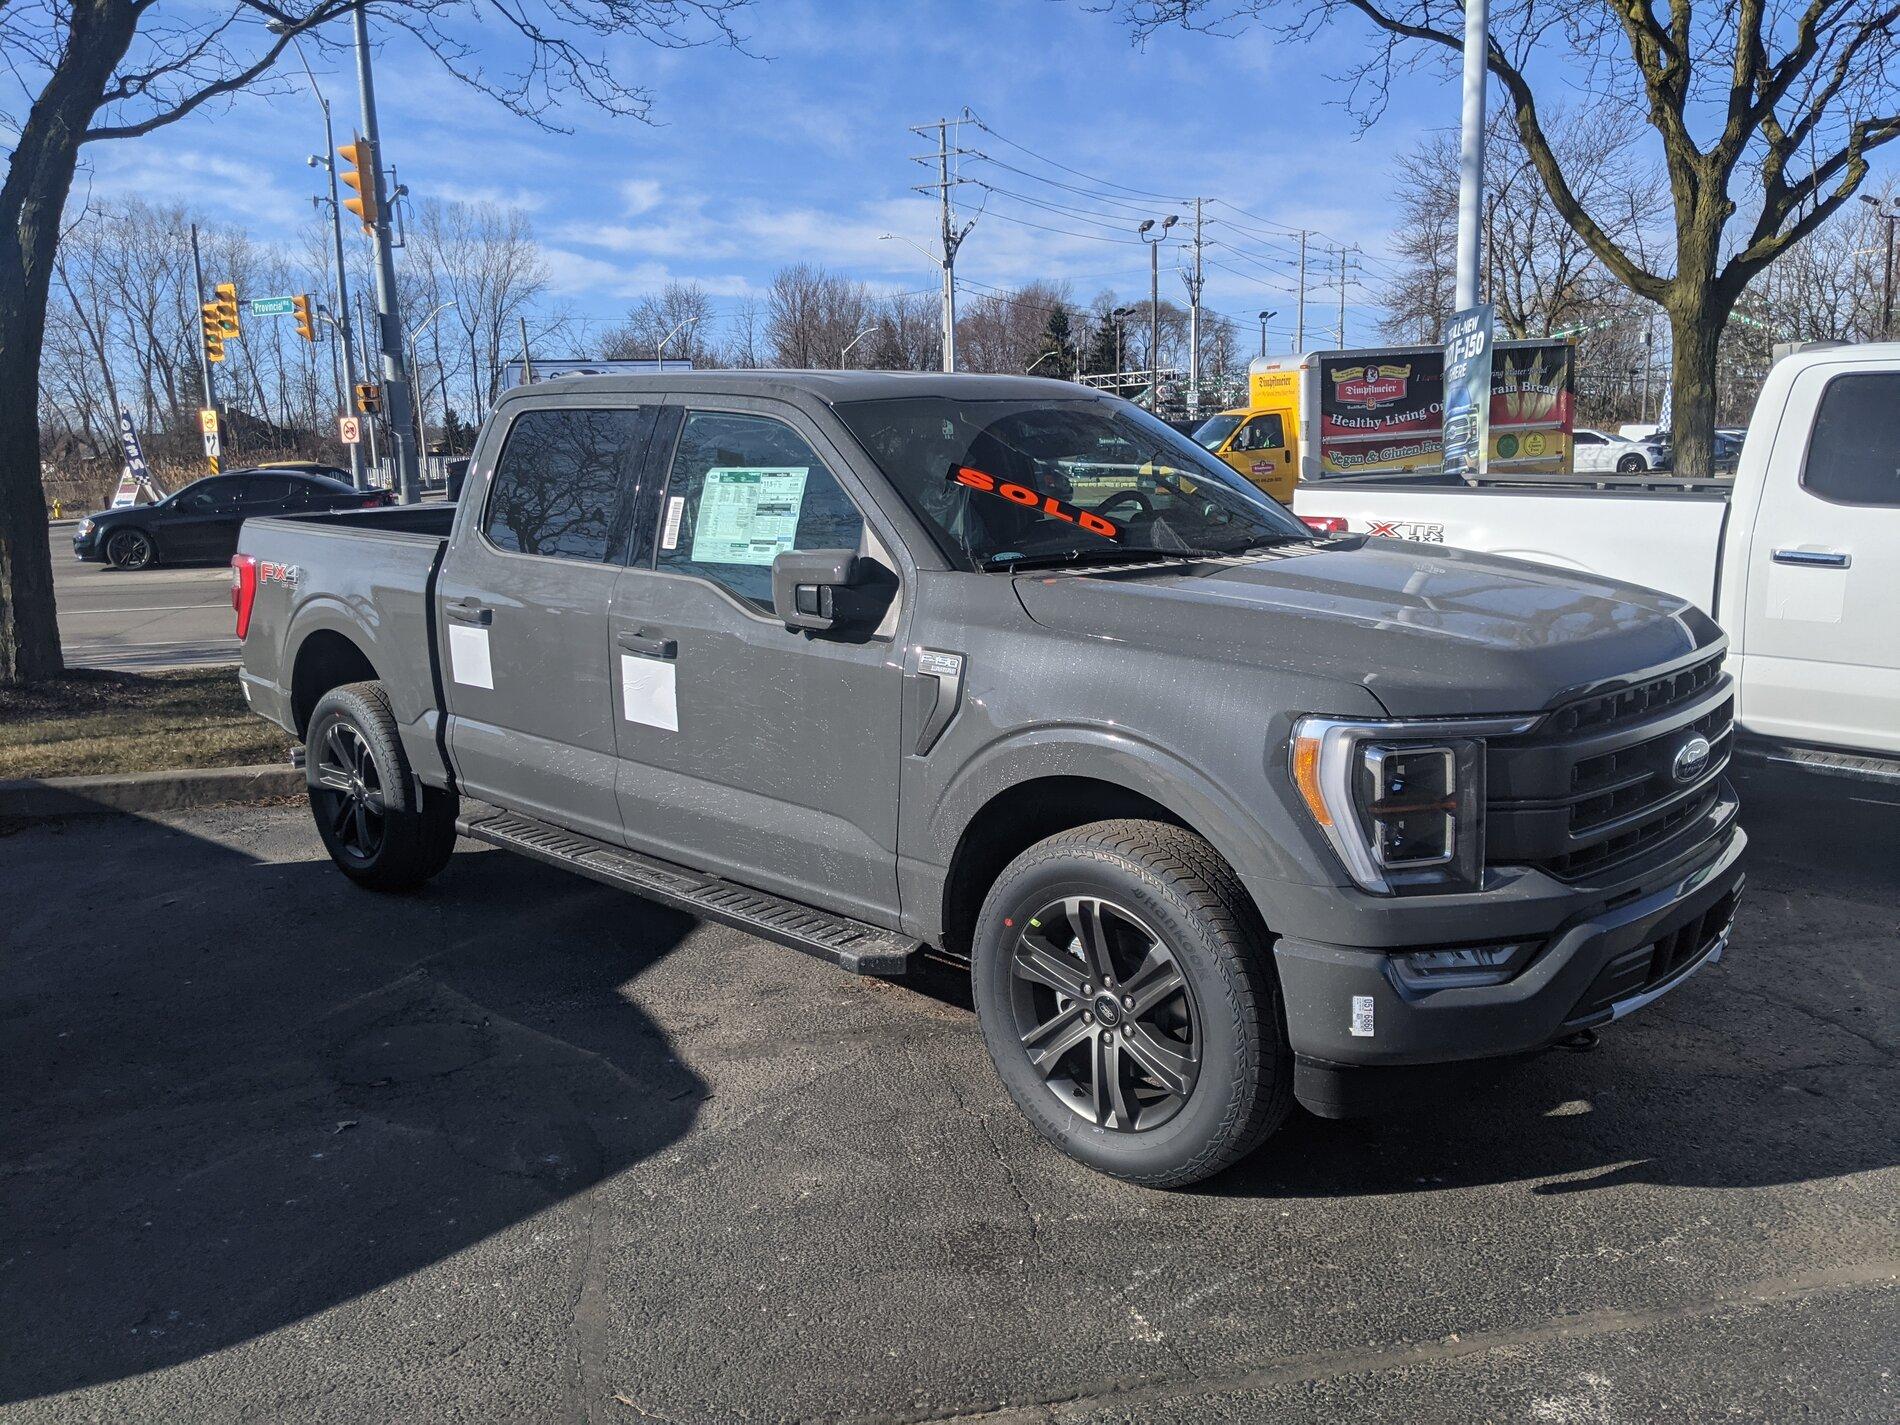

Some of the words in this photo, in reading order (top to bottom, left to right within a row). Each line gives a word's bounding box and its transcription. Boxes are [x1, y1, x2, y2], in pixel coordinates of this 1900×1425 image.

[254, 301, 283, 312] Provincial
[1454, 331, 1484, 363] F-150
[1331, 413, 1382, 429] Healthy
[1386, 408, 1427, 426] Living
[1490, 383, 1517, 395] rain
[1521, 381, 1558, 395] Bread
[1329, 450, 1364, 468] Vegan
[1366, 450, 1379, 464] &
[1381, 445, 1420, 461] Gluten
[957, 466, 1117, 537] SOLD
[1365, 520, 1445, 539] XTR
[261, 561, 299, 583] FX4
